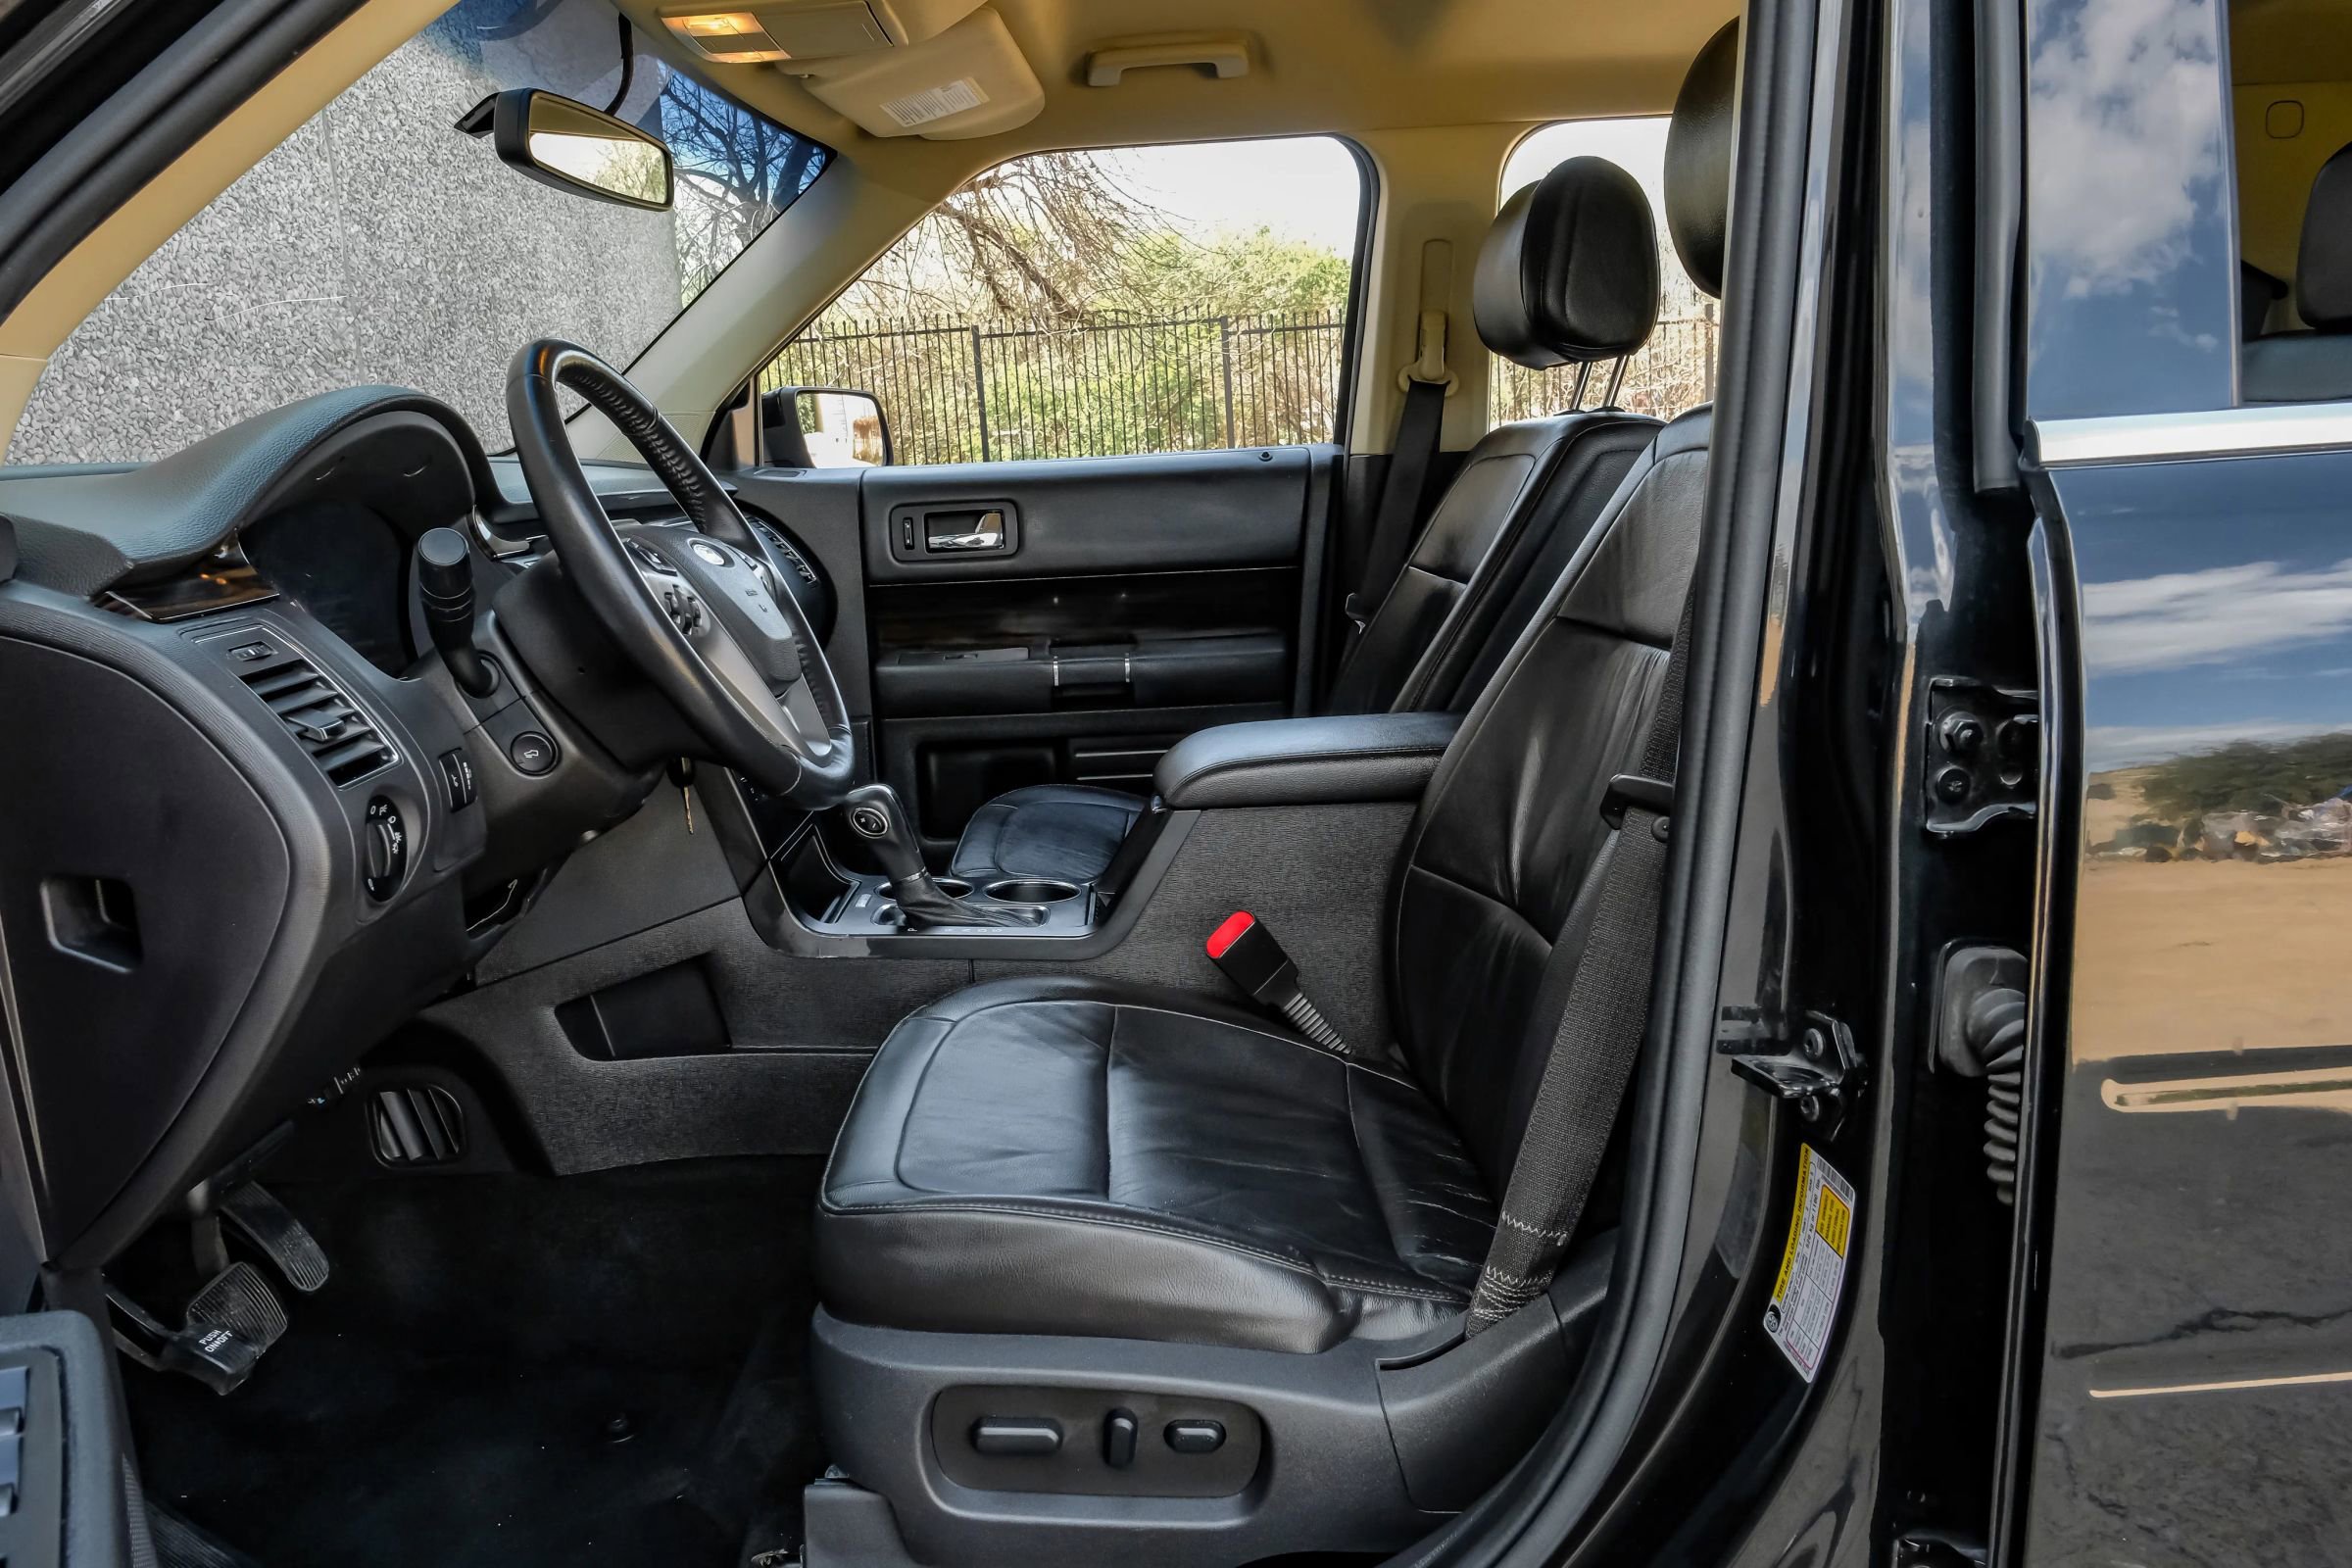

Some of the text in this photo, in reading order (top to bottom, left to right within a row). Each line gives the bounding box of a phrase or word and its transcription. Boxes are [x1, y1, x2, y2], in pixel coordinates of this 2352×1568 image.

[1776, 1278, 1786, 1298] TIRE
[1789, 1215, 1801, 1254] LOADING
[1798, 1148, 1809, 1213] INFORMATION
[199, 1329, 222, 1345] PUSH
